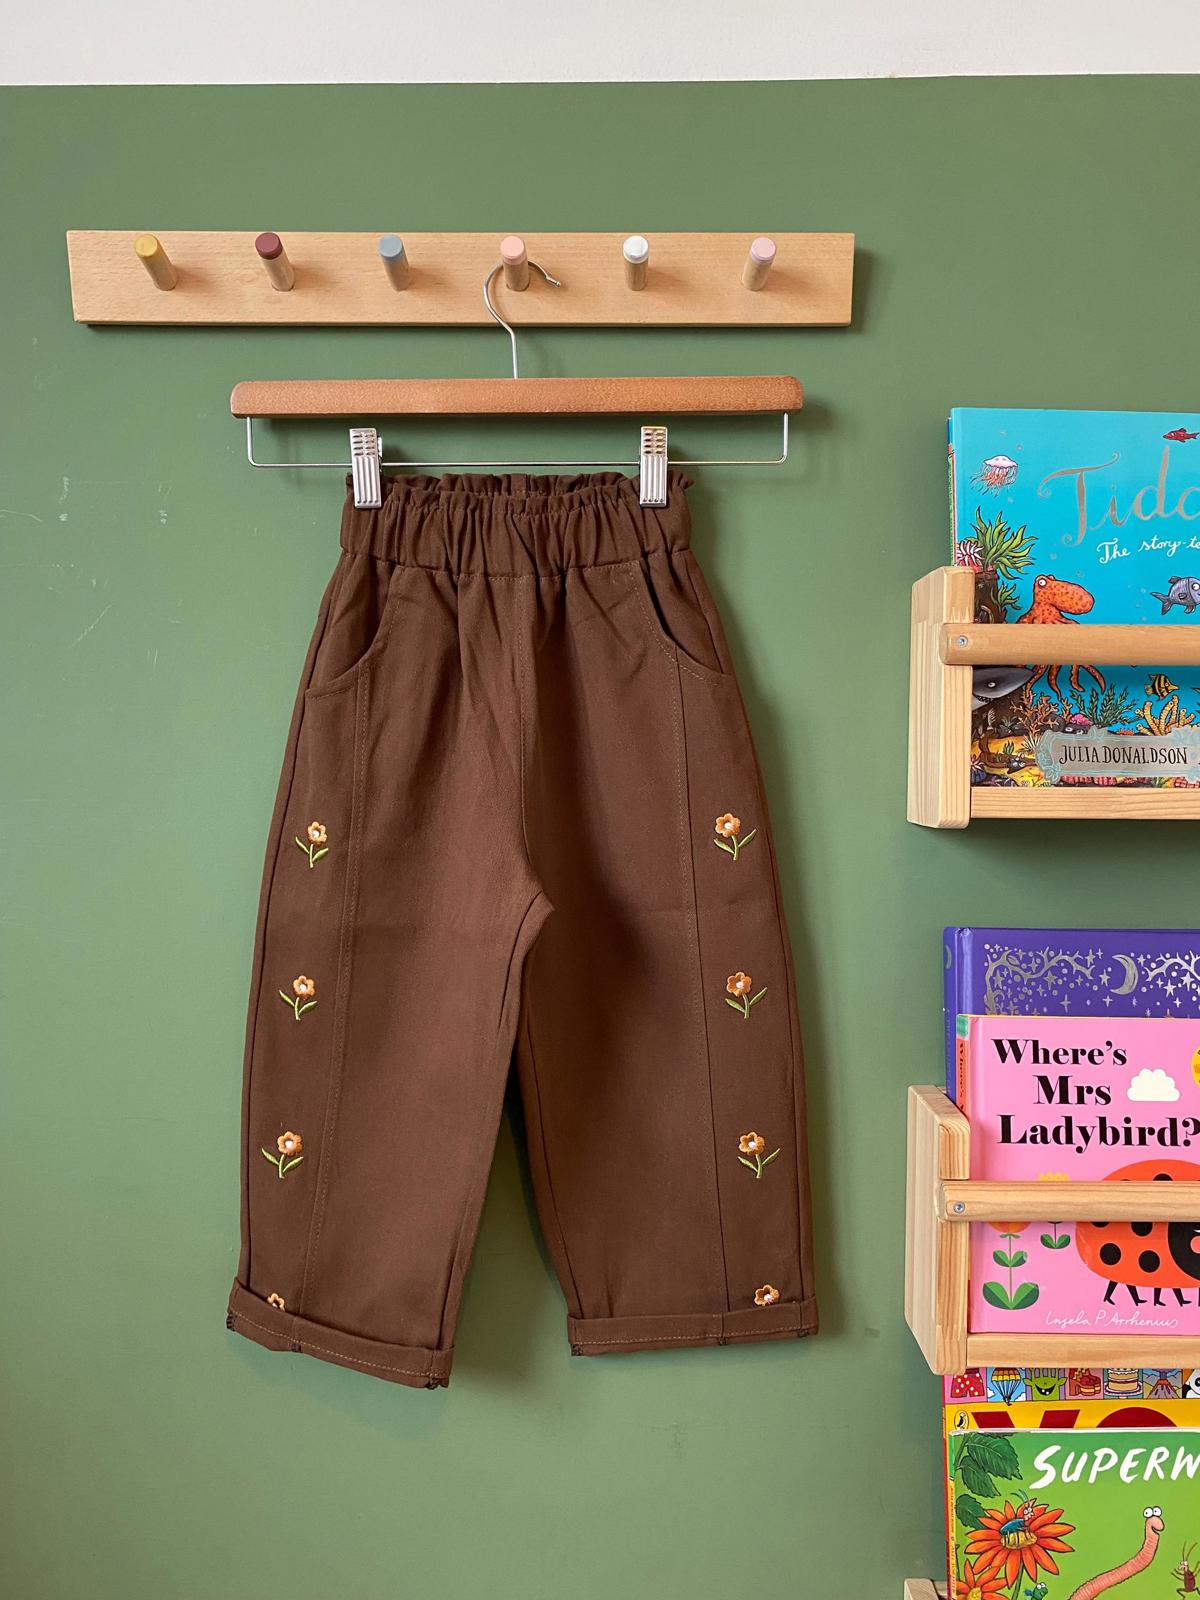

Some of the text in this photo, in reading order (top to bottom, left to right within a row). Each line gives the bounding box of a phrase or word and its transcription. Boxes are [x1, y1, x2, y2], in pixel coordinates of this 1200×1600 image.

[1096, 537, 1131, 564] The
[1058, 745, 1188, 765] JULIA DONALDSON
[991, 1038, 1128, 1066] Where's
[1033, 1074, 1112, 1106] Mrs
[996, 1113, 1200, 1154] Ladybird?
[1095, 1309, 1107, 1325] P
[1028, 1444, 1200, 1490] SUPERW
